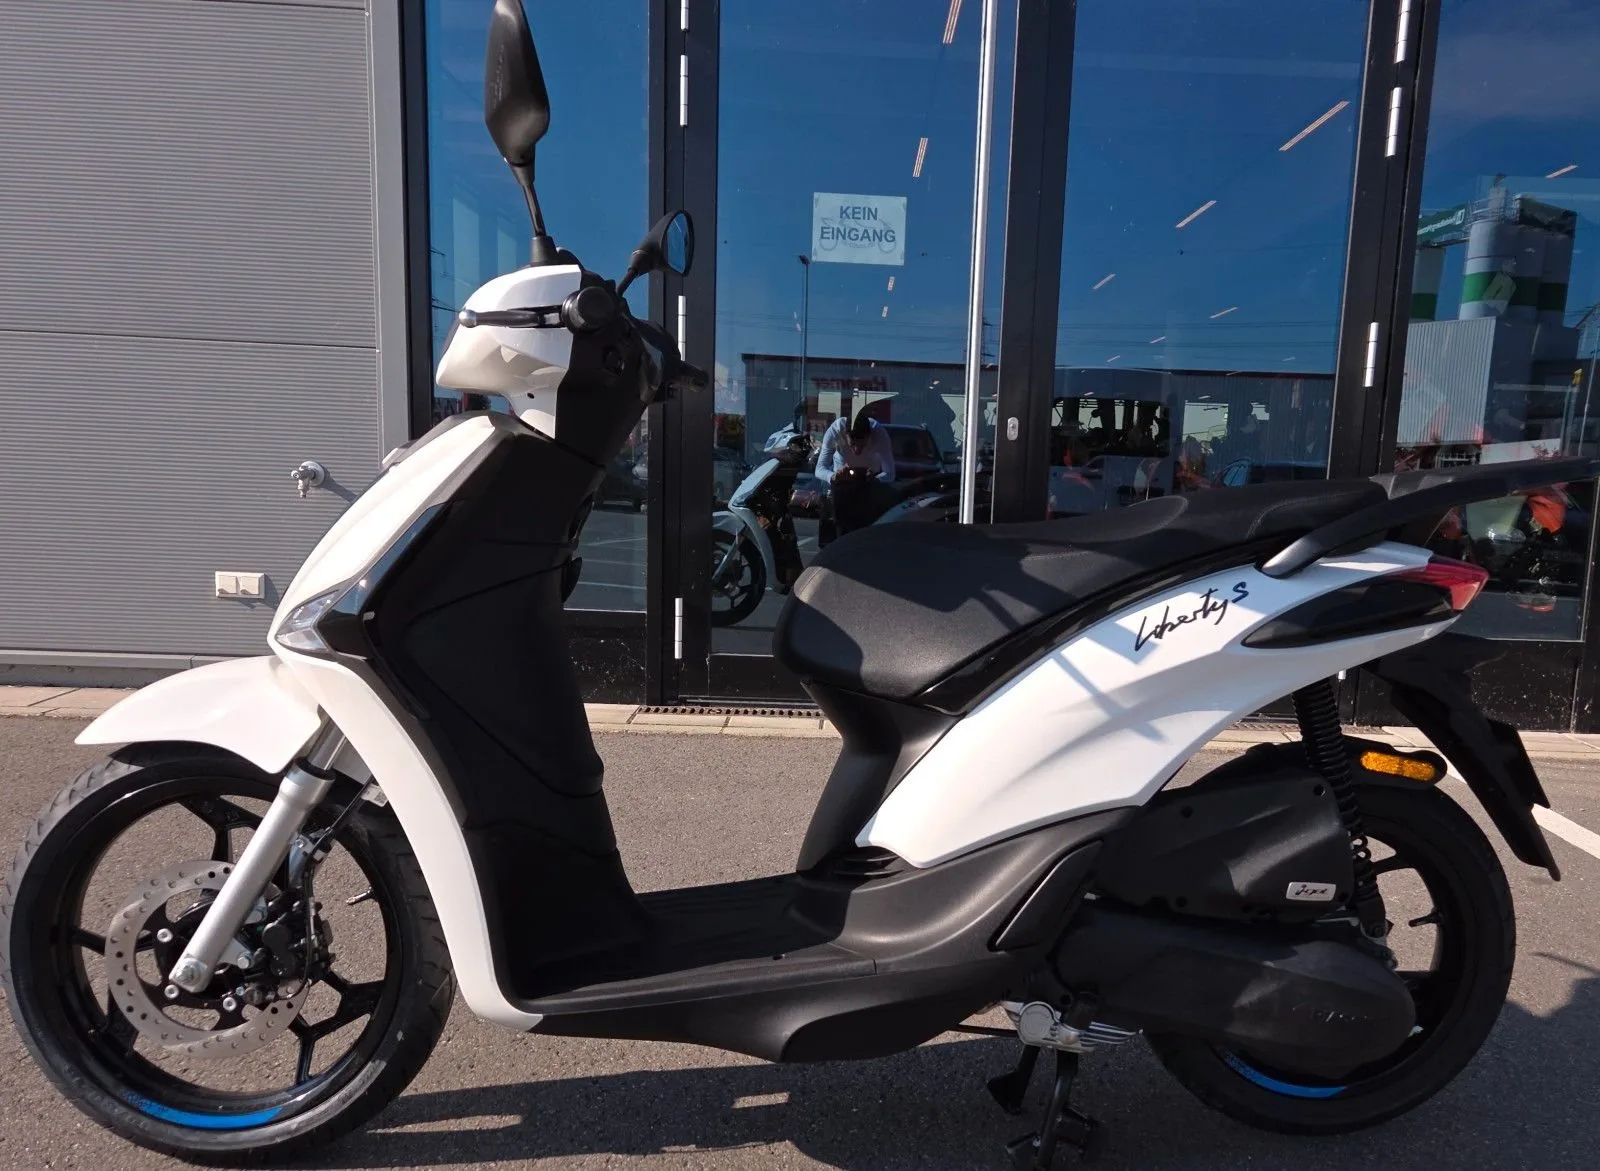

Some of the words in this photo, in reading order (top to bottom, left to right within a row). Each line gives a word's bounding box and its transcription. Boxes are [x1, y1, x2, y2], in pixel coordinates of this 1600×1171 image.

[840, 205, 878, 220] KEIN
[820, 226, 896, 242] EINGANG
[1134, 588, 1229, 651] Liberty
